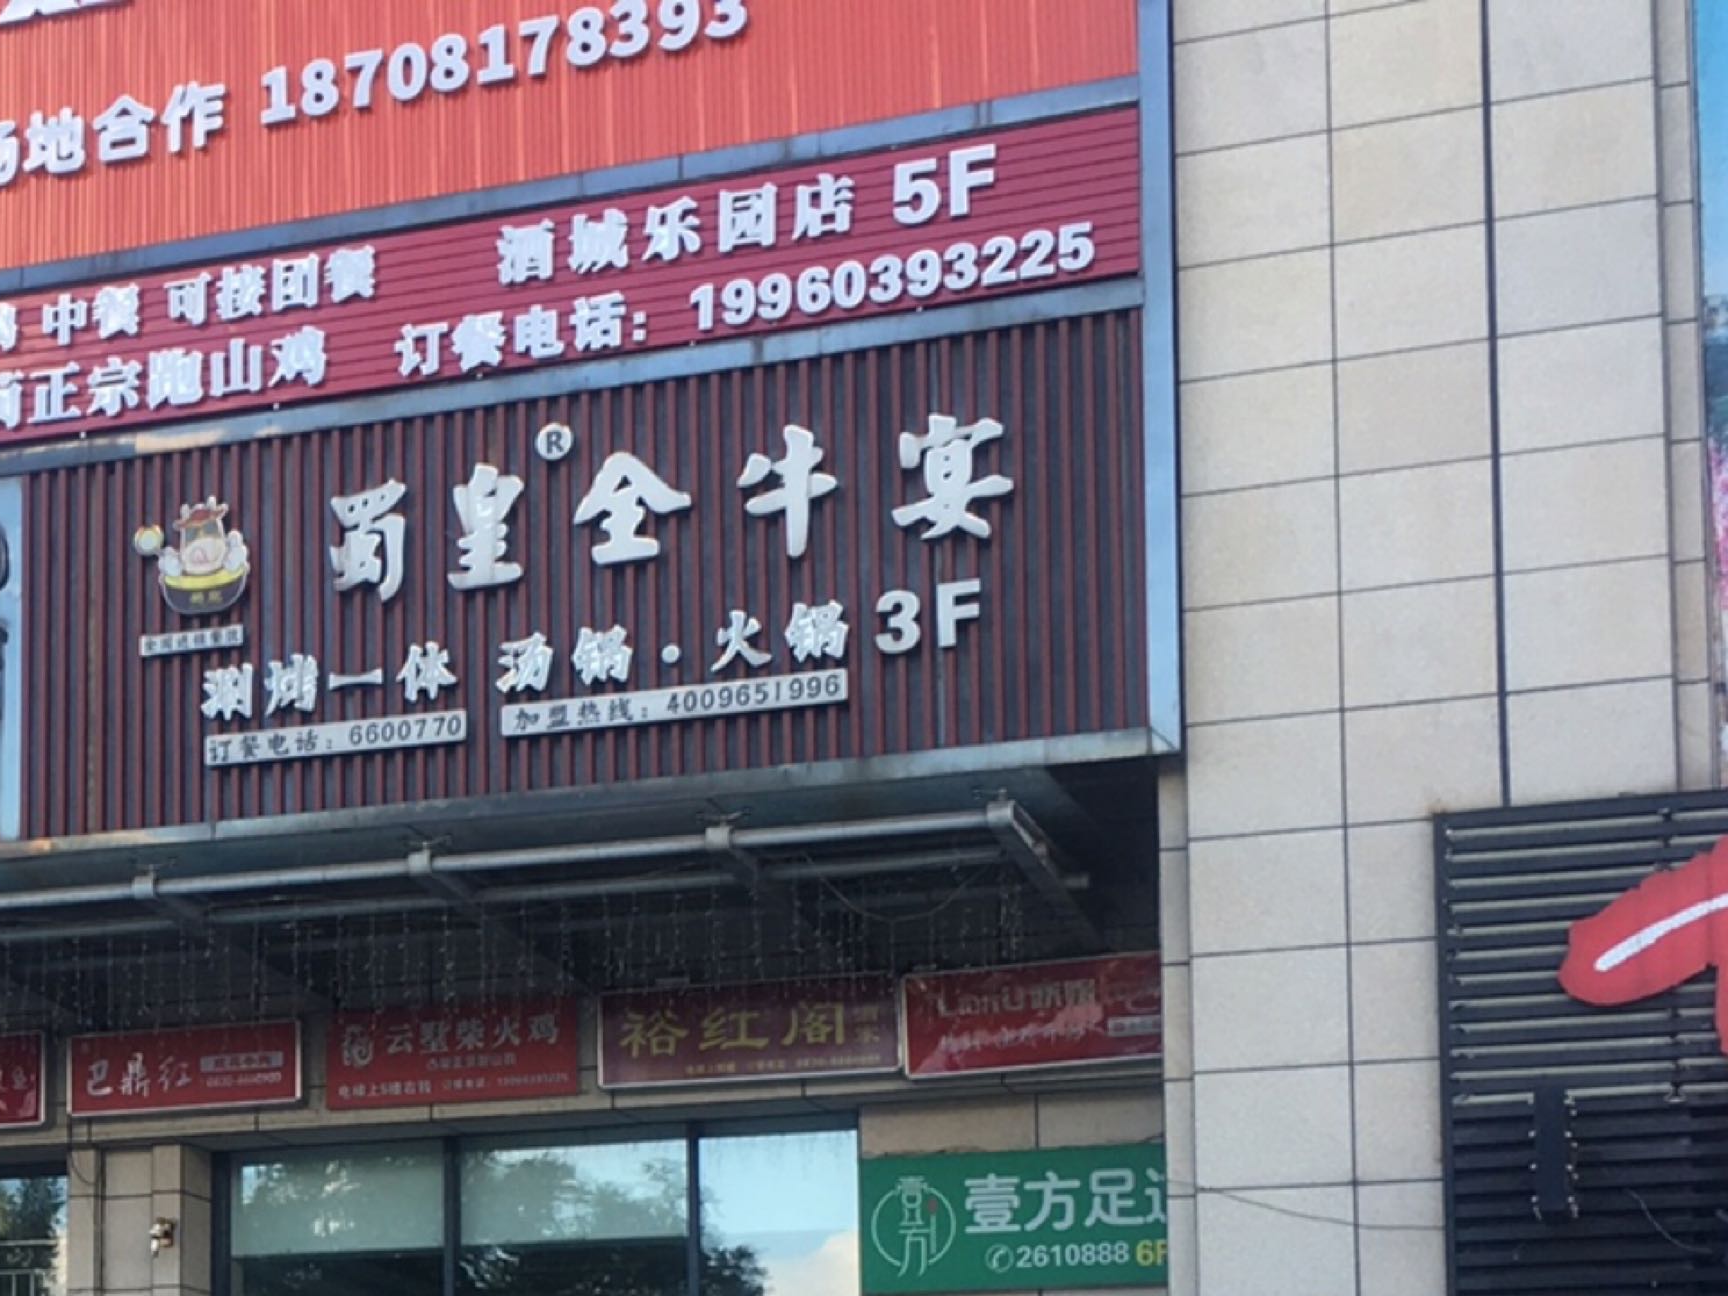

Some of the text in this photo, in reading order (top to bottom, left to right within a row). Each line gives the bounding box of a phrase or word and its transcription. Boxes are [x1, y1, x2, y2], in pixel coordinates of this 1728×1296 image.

[259, 0, 748, 126] 18708178393
[495, 144, 998, 287] 酒城乐园店 5F
[41, 284, 140, 346] 中餐
[164, 245, 378, 325] 可接团餐
[689, 221, 1095, 332] 19960393225
[875, 578, 982, 656] 3F
[666, 669, 842, 714] 4009651996
[348, 715, 463, 748] 6600770
[619, 1001, 847, 1058] 裕红阁
[1016, 1241, 1131, 1268] 2610888
